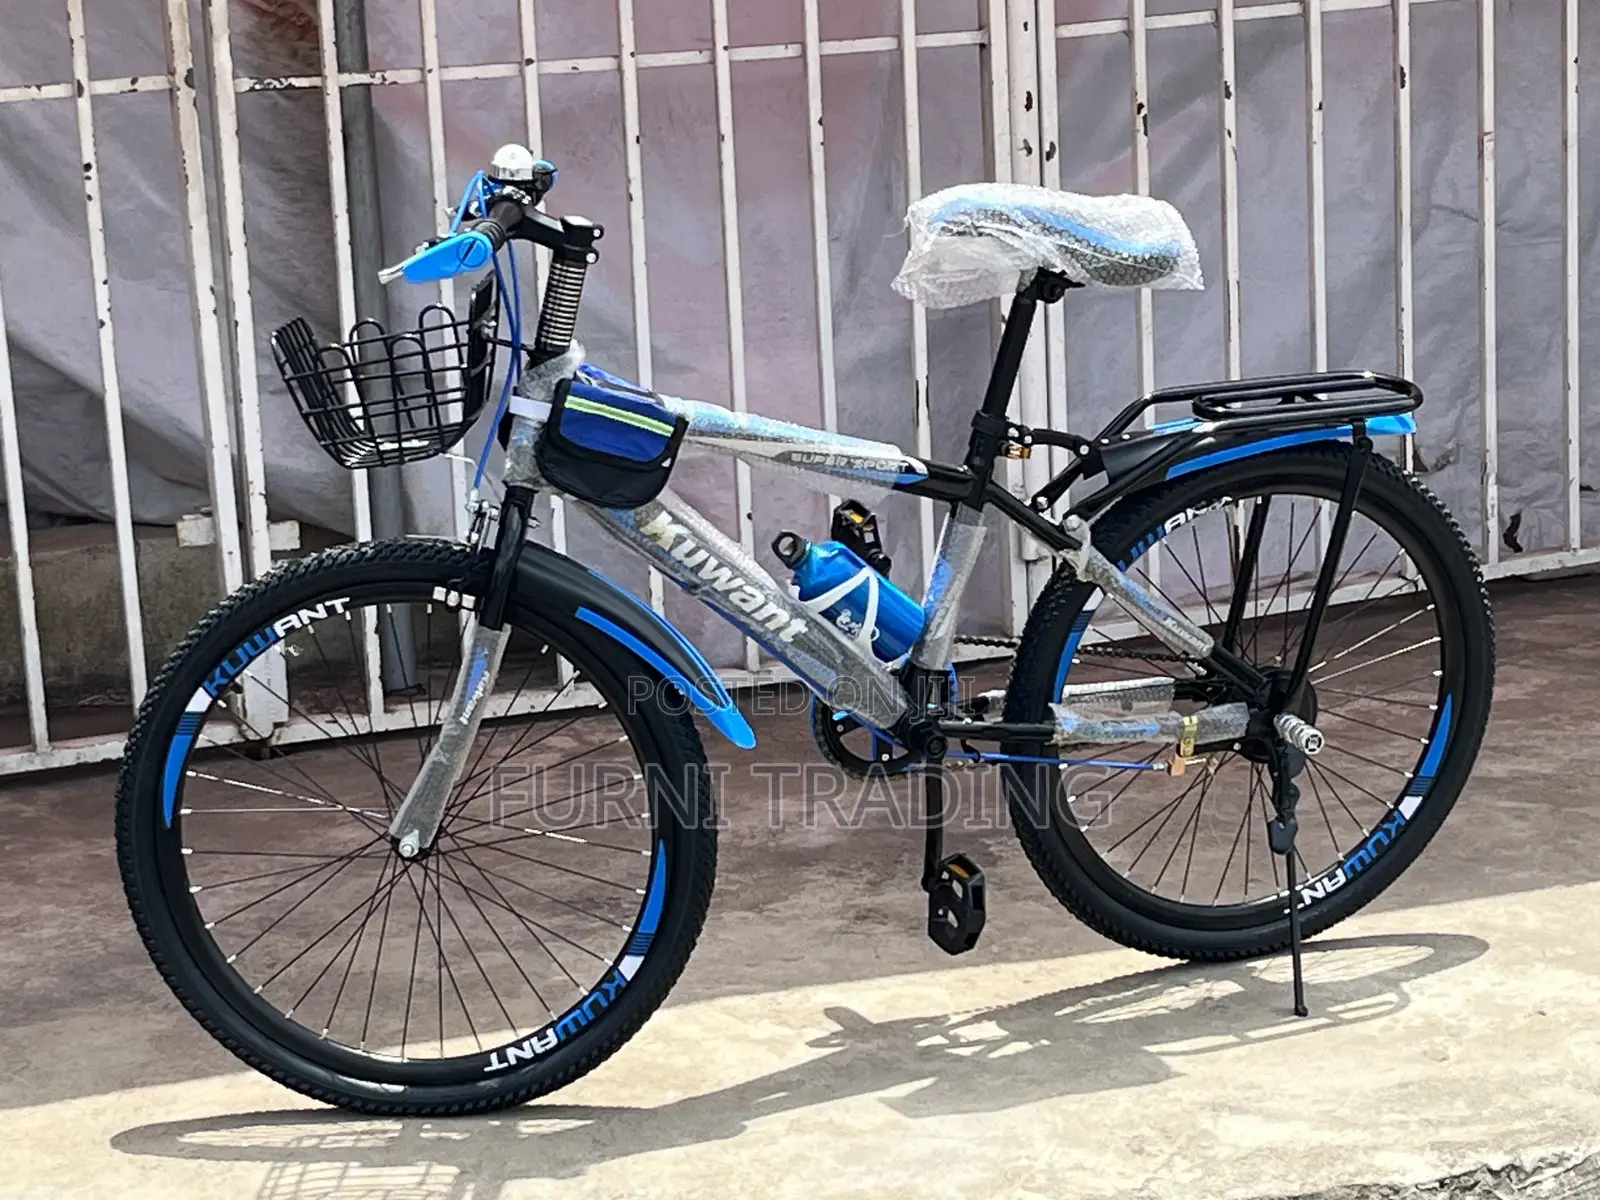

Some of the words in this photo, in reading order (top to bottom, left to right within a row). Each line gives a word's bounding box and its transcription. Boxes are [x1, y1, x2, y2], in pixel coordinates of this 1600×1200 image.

[790, 451, 848, 468] SUPER
[639, 510, 808, 642] Kuwant
[203, 597, 350, 697] KUWANT
[483, 968, 628, 1072] KUWANT
